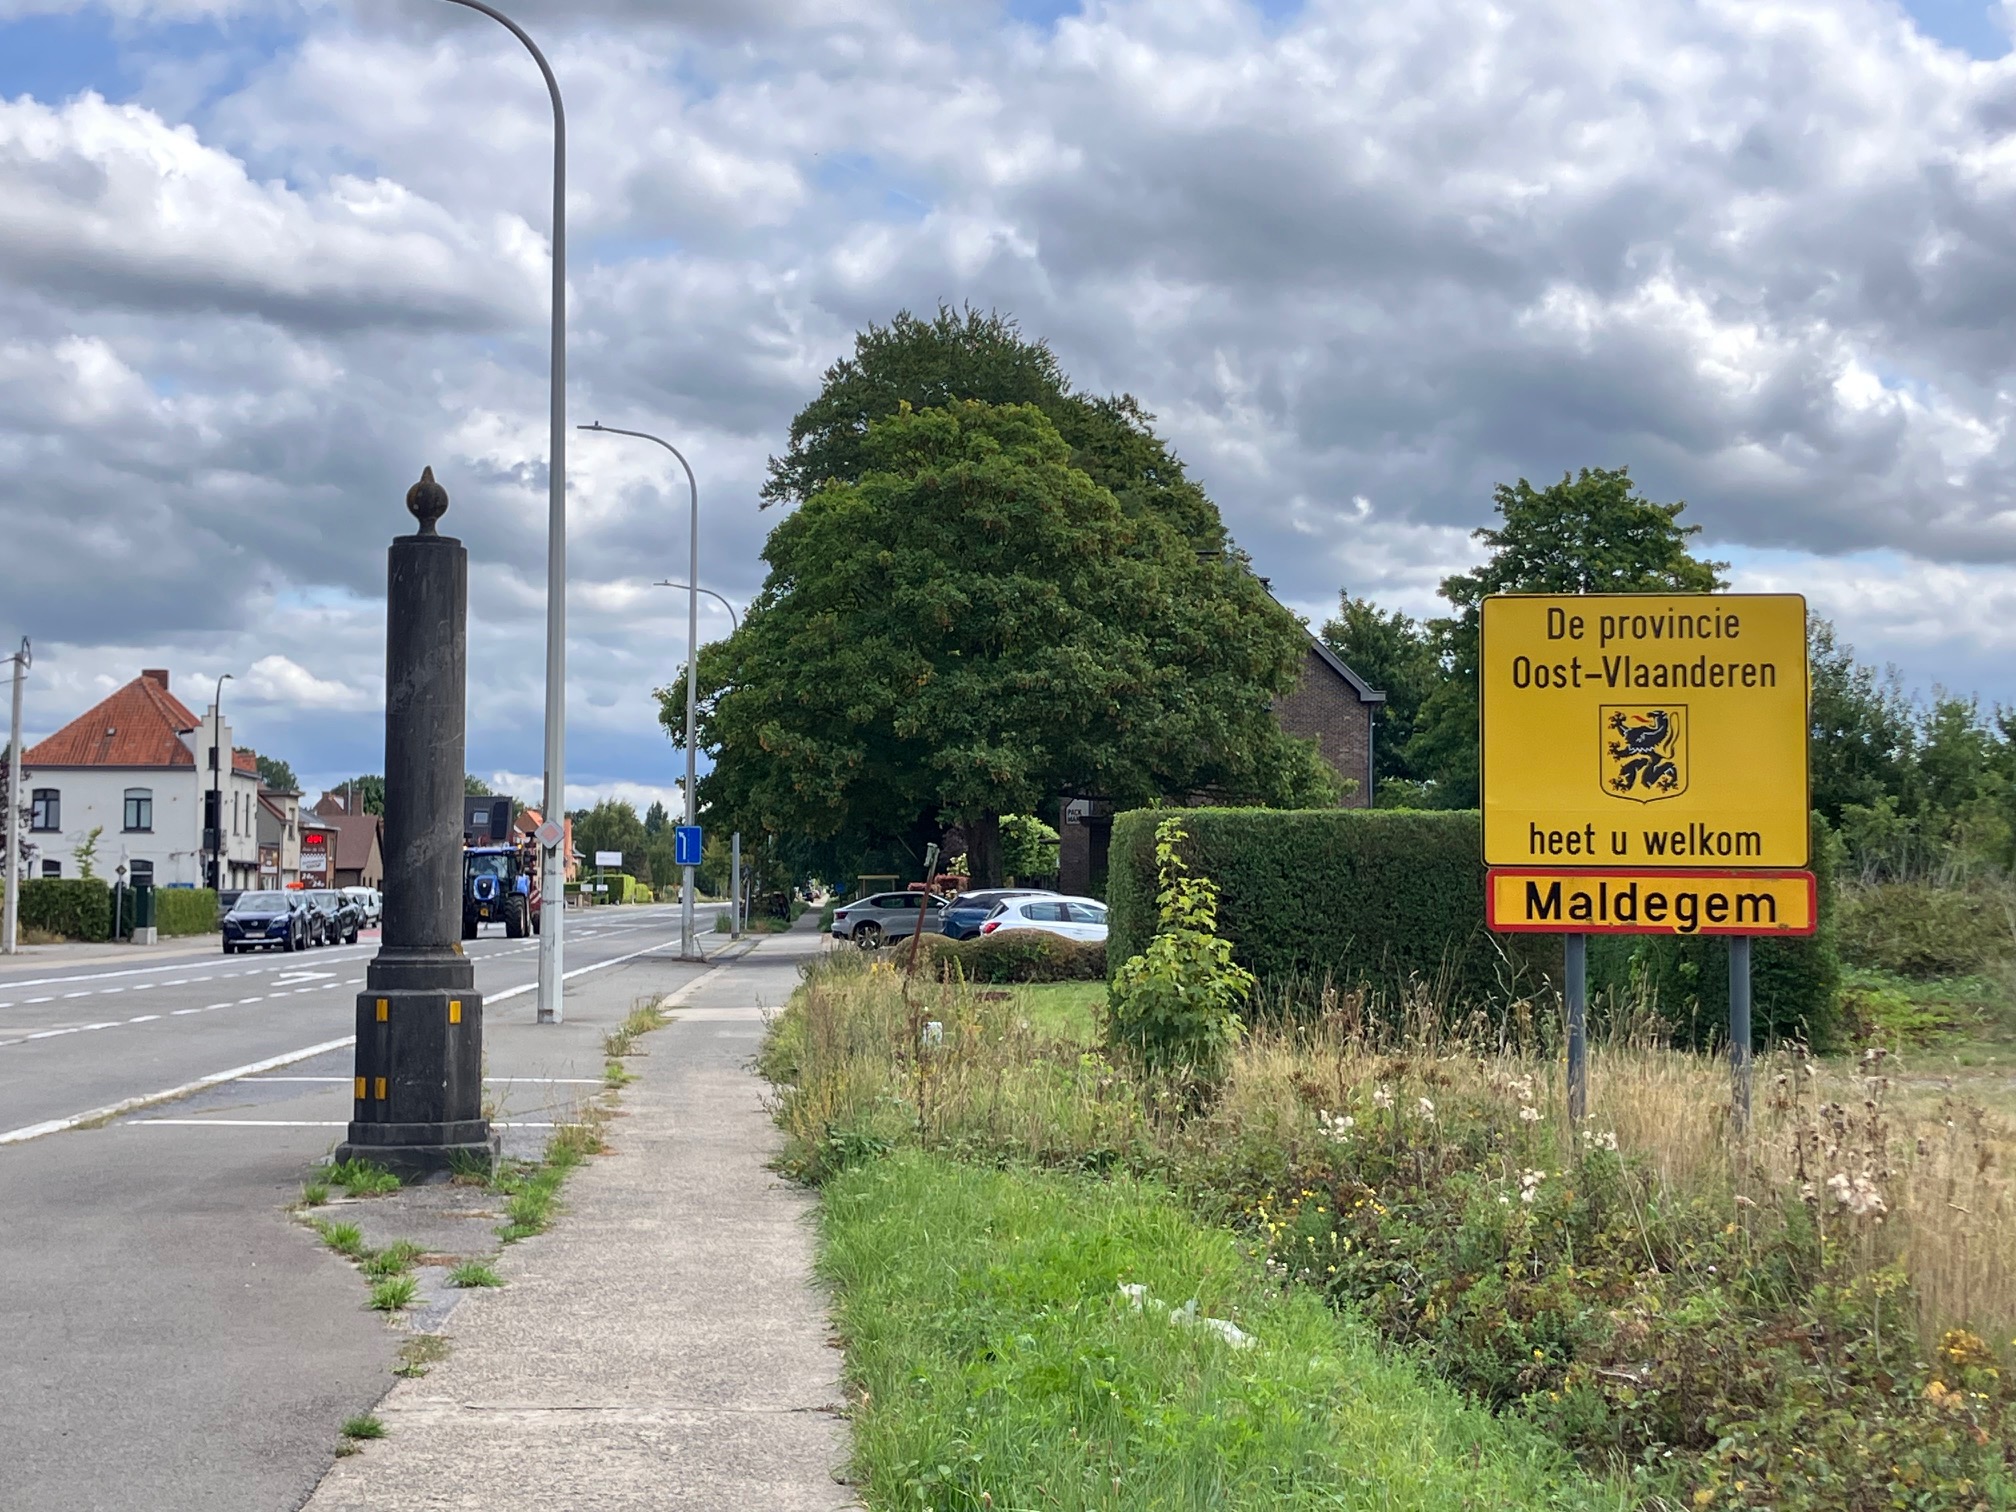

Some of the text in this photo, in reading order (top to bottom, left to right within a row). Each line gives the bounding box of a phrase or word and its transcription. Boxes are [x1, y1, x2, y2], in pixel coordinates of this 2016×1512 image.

[1547, 606, 1740, 648] De provincie
[1513, 655, 1776, 688] Oost-Vlaanderen
[1530, 822, 1761, 856] heet u welkom
[1526, 881, 1776, 934] Maldegem
